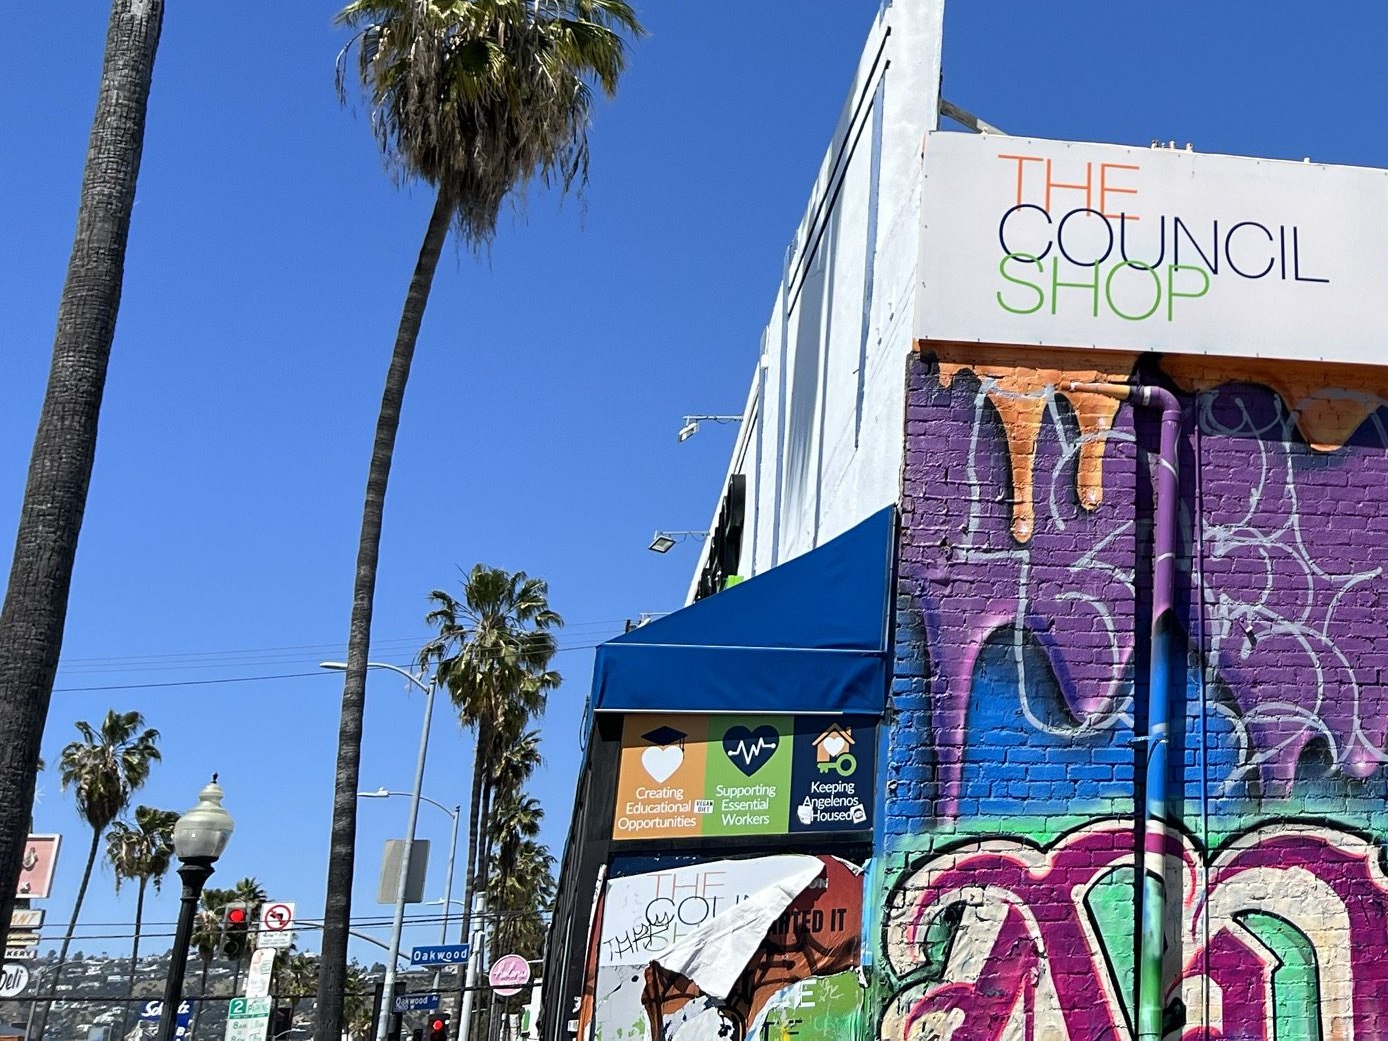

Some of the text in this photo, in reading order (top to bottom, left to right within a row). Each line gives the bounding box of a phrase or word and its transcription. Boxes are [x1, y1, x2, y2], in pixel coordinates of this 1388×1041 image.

[998, 154, 1140, 220] THE
[999, 204, 1330, 283] COUNCIL
[997, 252, 1210, 321] SHOP
[636, 786, 684, 800] Creating
[716, 783, 776, 798] Supporting
[811, 781, 855, 794] Keeping
[626, 800, 691, 815] Educational
[721, 798, 769, 812] Essential
[803, 795, 859, 809] Angelenos
[721, 813, 769, 826] Workers
[811, 809, 852, 822] Housed
[618, 815, 696, 831] Opportunities
[647, 871, 727, 900] THE
[831, 908, 847, 932] IT
[413, 949, 468, 961] Oakwood
[233, 1000, 244, 1013] 2
[396, 995, 428, 1006] Oakwood
